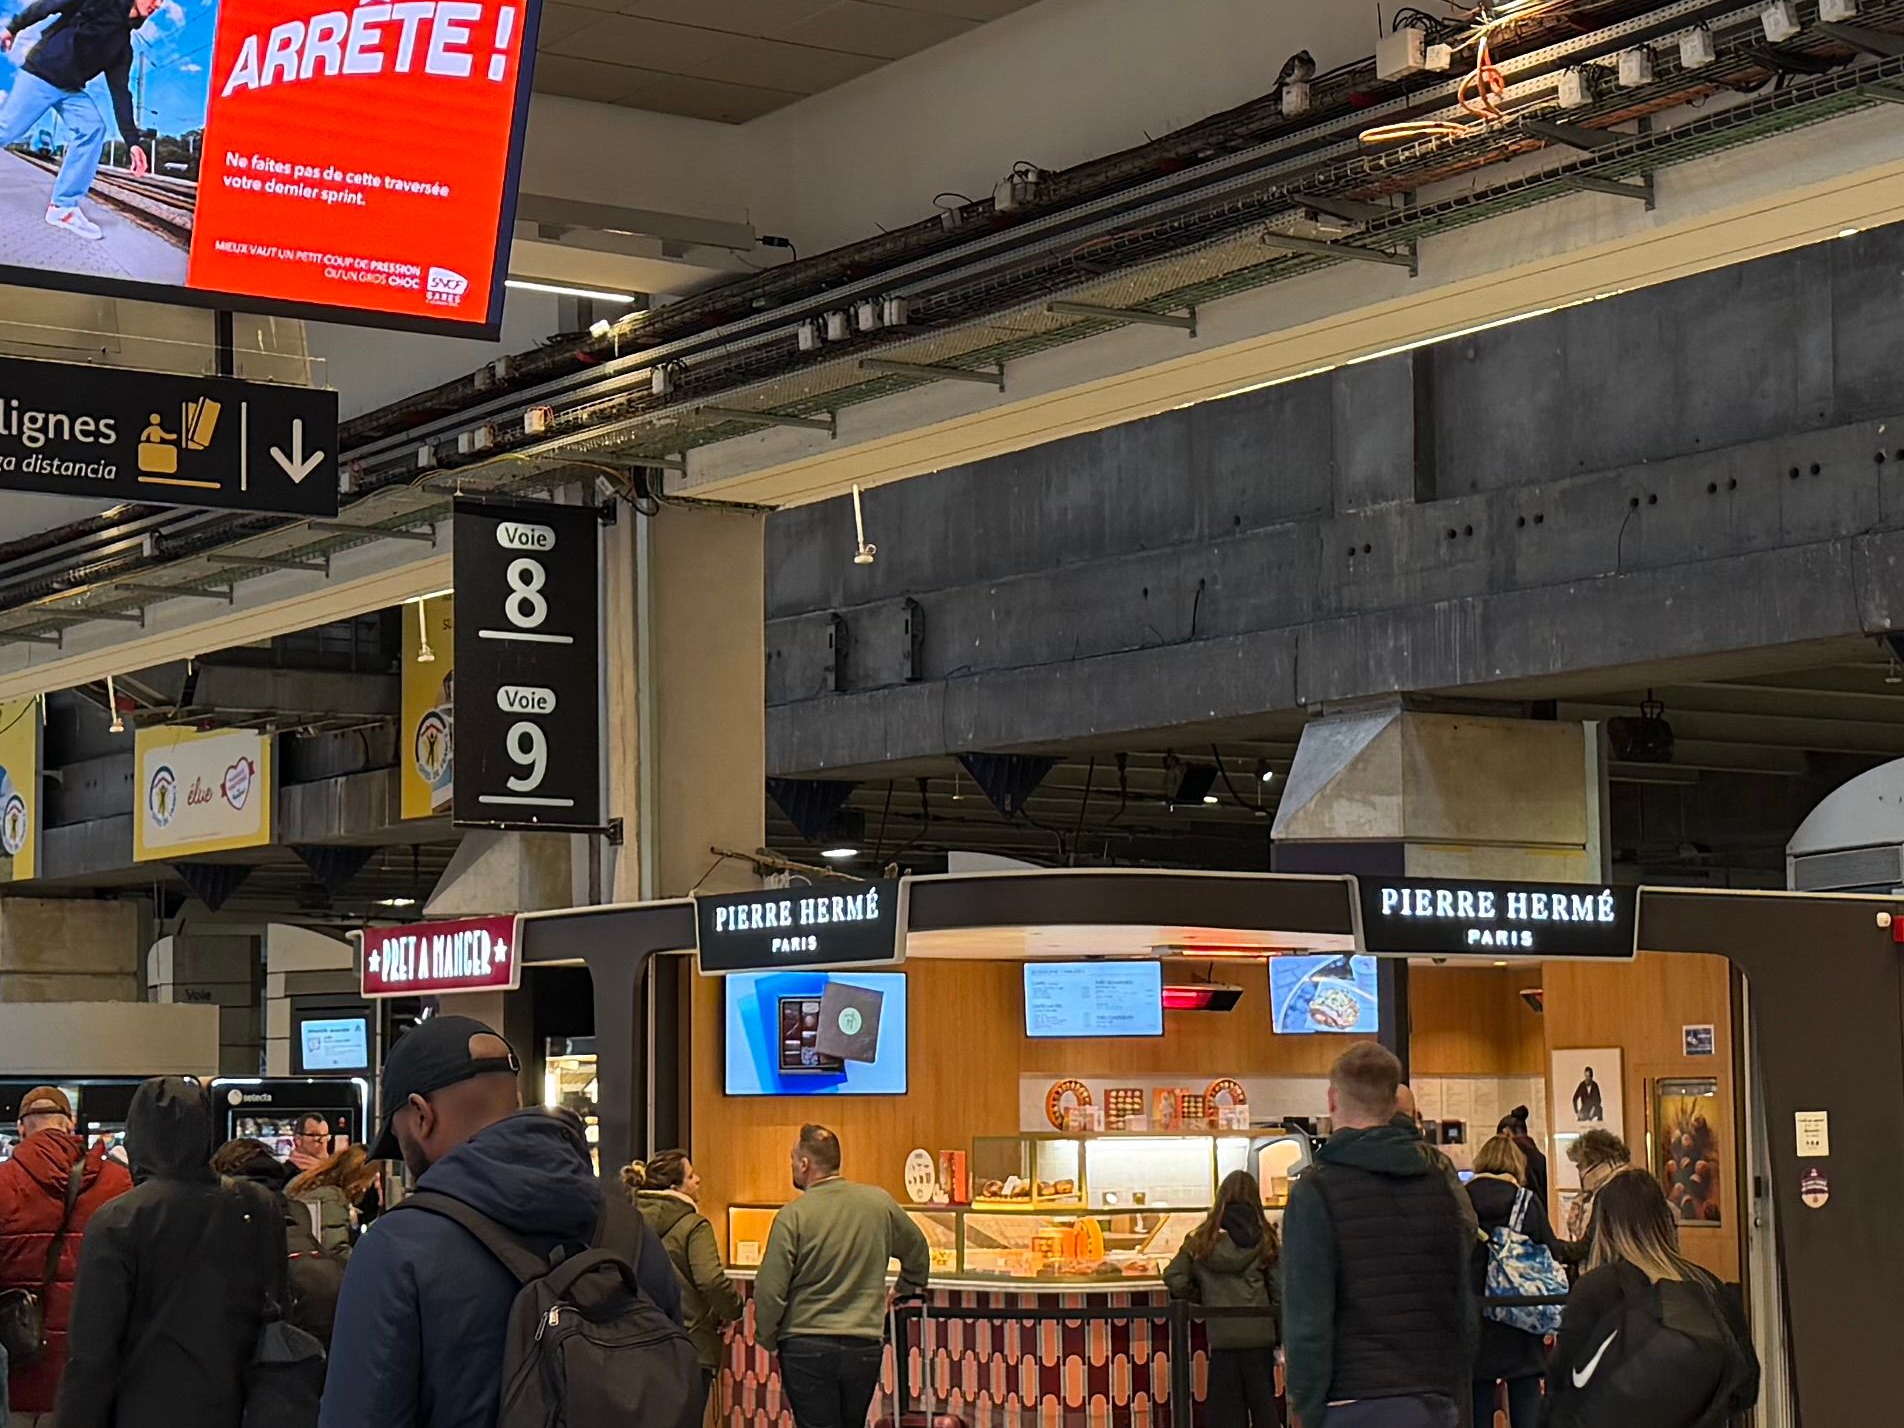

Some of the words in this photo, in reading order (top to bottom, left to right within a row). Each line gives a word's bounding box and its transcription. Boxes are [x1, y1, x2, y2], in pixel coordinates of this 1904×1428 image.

[223, 175, 262, 193] votre
[264, 178, 318, 200] dernier
[225, 151, 248, 169] Ne
[251, 154, 292, 176] faites
[294, 163, 321, 180] pas
[323, 164, 344, 182] de
[346, 170, 382, 188] cette
[384, 173, 450, 199] traversée
[20, 451, 118, 482] distancia
[504, 525, 548, 548] Voie
[504, 557, 548, 629] 8
[504, 688, 548, 711] Voie
[506, 721, 547, 792] 9
[715, 900, 793, 933] PIERRE
[798, 885, 880, 926] HERMÉ
[1380, 887, 1497, 919] PIERRE
[1505, 887, 1616, 923] HERMÉ
[770, 934, 819, 954] PARIS
[1466, 928, 1534, 947] PARIS
